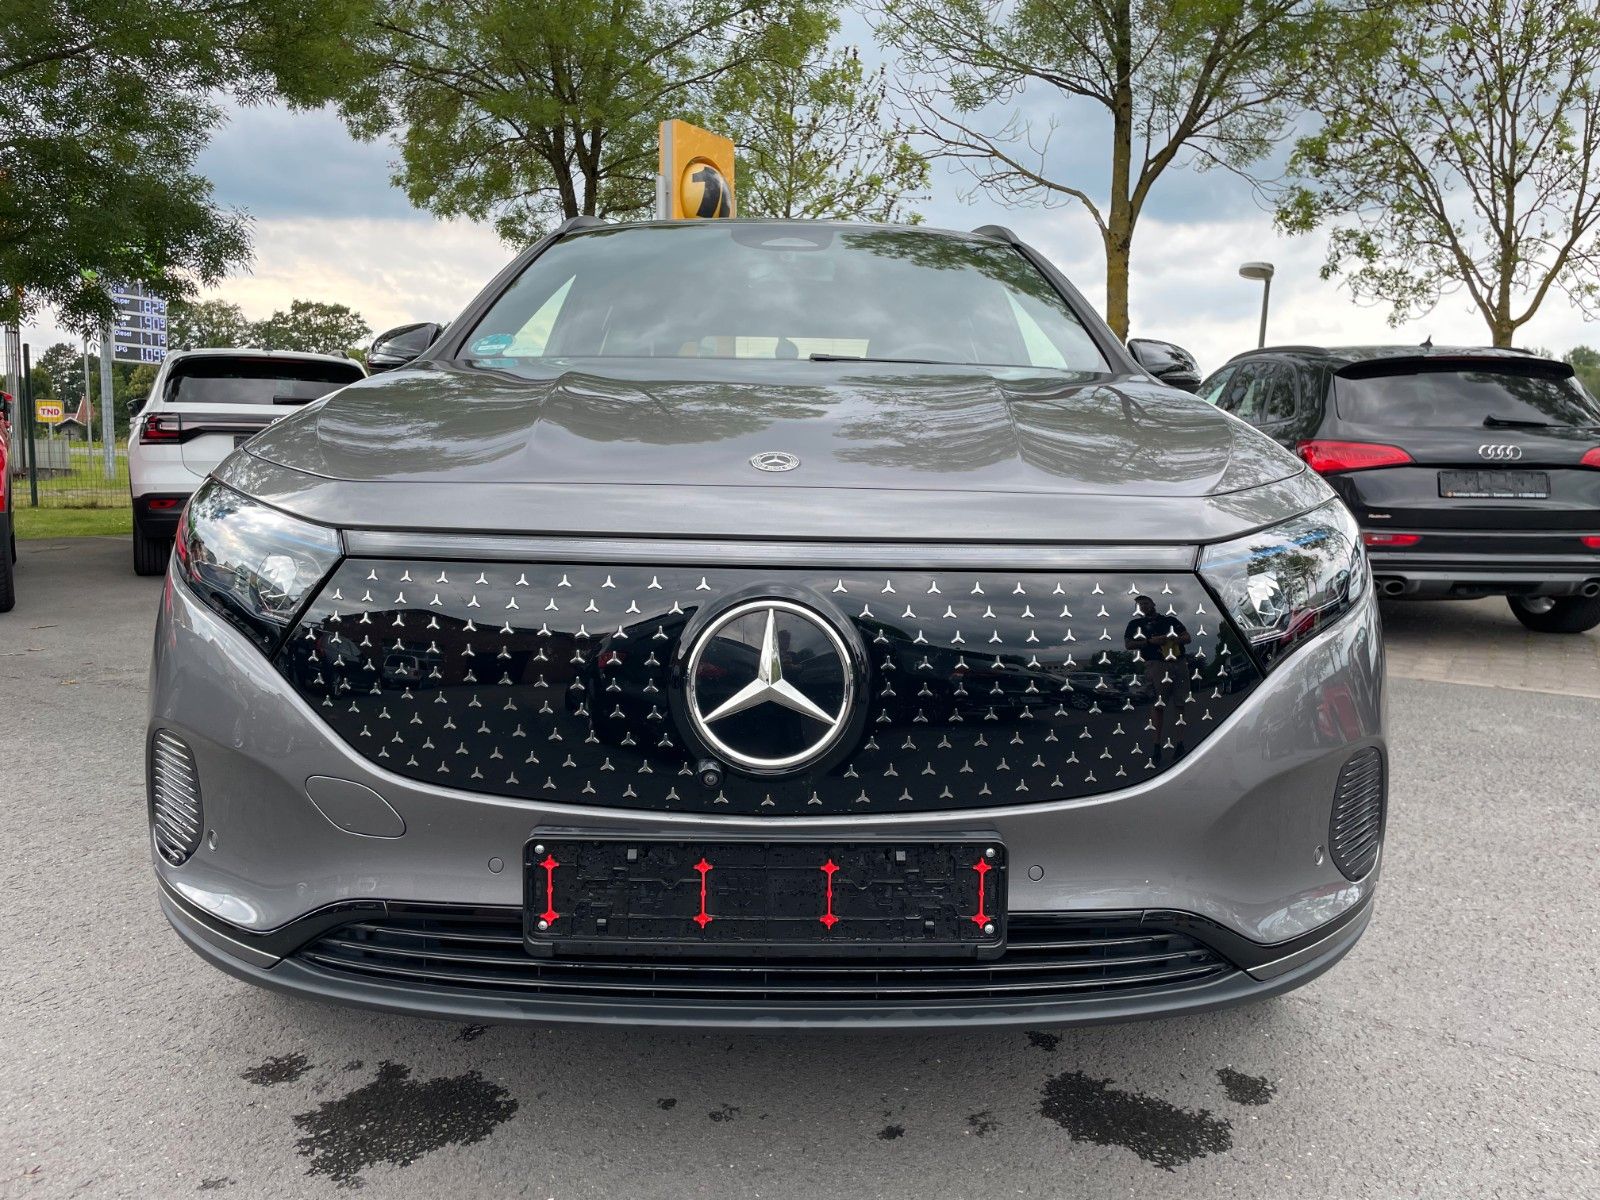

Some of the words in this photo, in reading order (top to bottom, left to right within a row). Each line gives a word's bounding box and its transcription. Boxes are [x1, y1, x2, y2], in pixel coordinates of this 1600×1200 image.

[113, 297, 130, 305] Super
[114, 329, 132, 337] Diesel
[115, 345, 128, 353] LPG
[40, 408, 60, 416] TND
